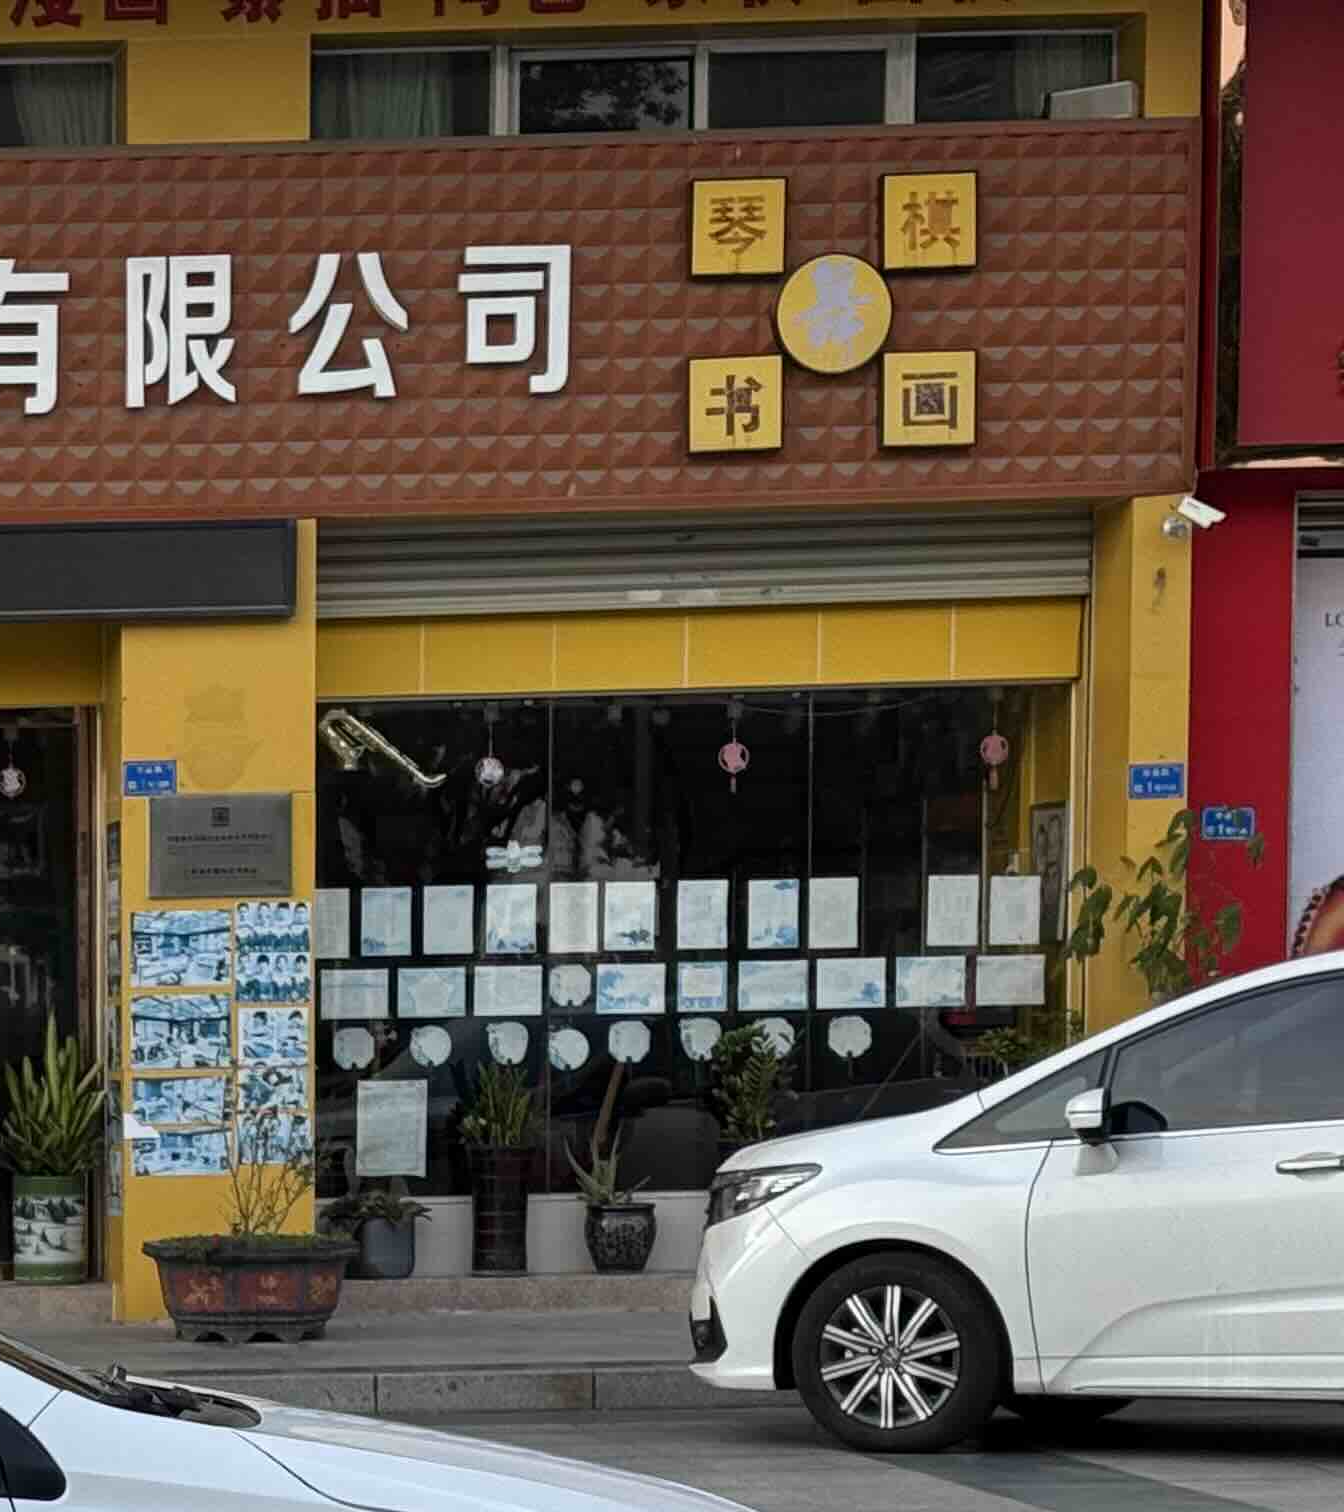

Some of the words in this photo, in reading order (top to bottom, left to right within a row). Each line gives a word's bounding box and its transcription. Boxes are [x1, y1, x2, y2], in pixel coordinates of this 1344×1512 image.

[708, 194, 768, 256] 琴
[705, 373, 763, 437] 书
[901, 370, 959, 430] 画
